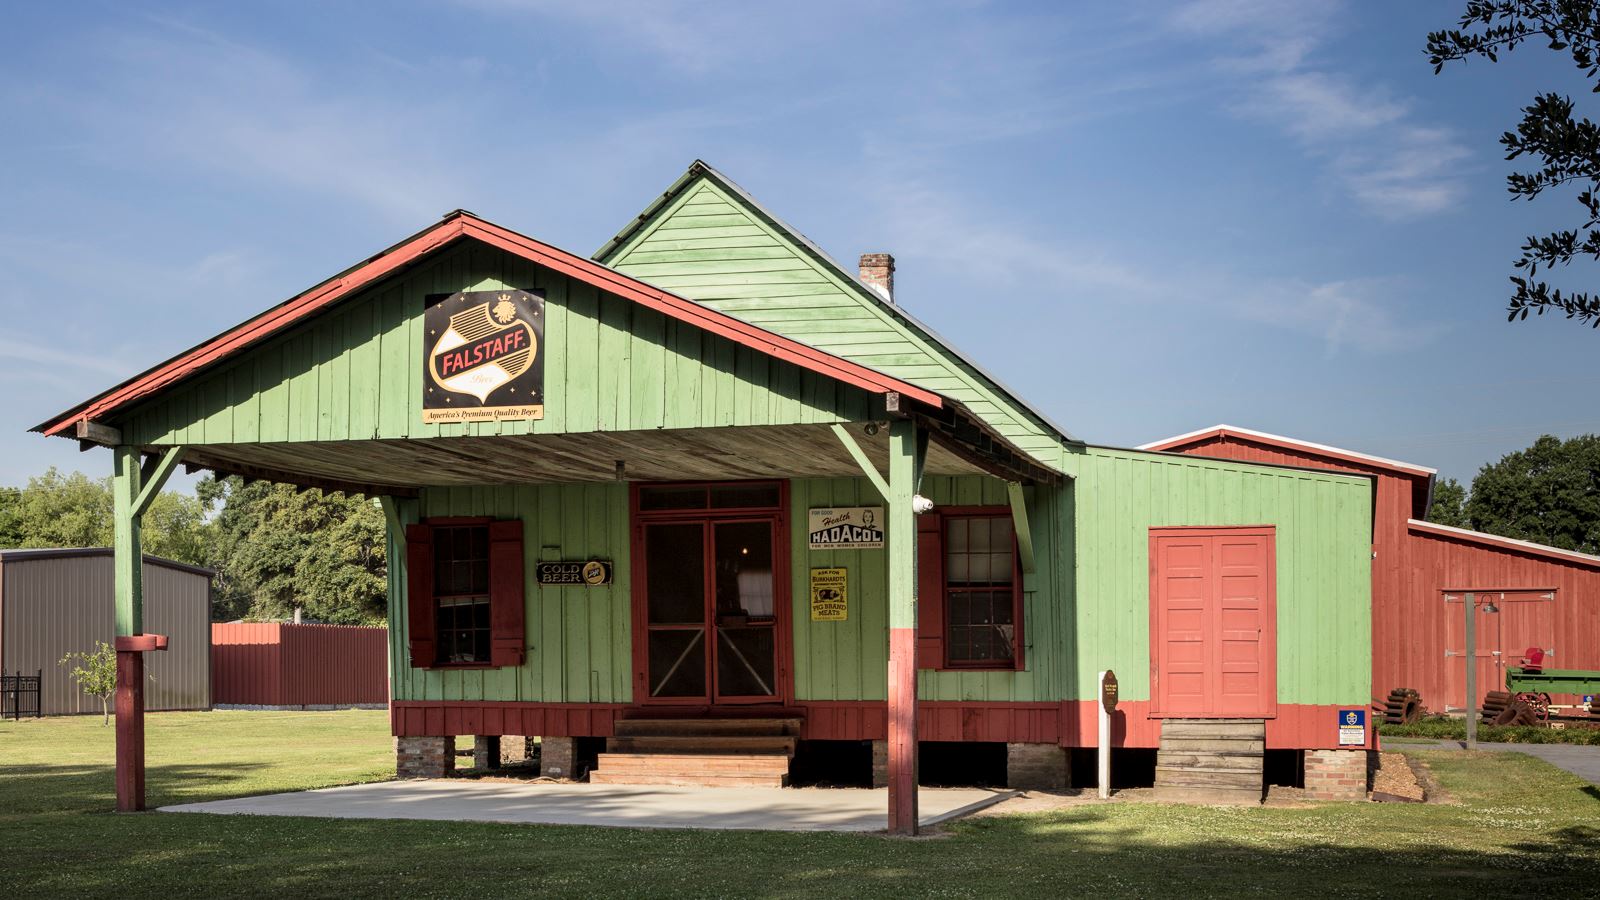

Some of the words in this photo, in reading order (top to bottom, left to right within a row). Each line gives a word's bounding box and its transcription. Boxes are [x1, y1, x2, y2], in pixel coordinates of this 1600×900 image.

[442, 329, 524, 376] FALSTAFF
[428, 410, 460, 420] America's
[461, 410, 493, 419] Premium
[494, 408, 519, 419] Quality
[520, 408, 538, 416] Beer
[822, 512, 851, 526] Health
[812, 525, 881, 543] HADACOL
[542, 565, 580, 573] COLD
[542, 574, 581, 582] BEER
[812, 604, 824, 612] PIG
[824, 603, 847, 611] BRAND
